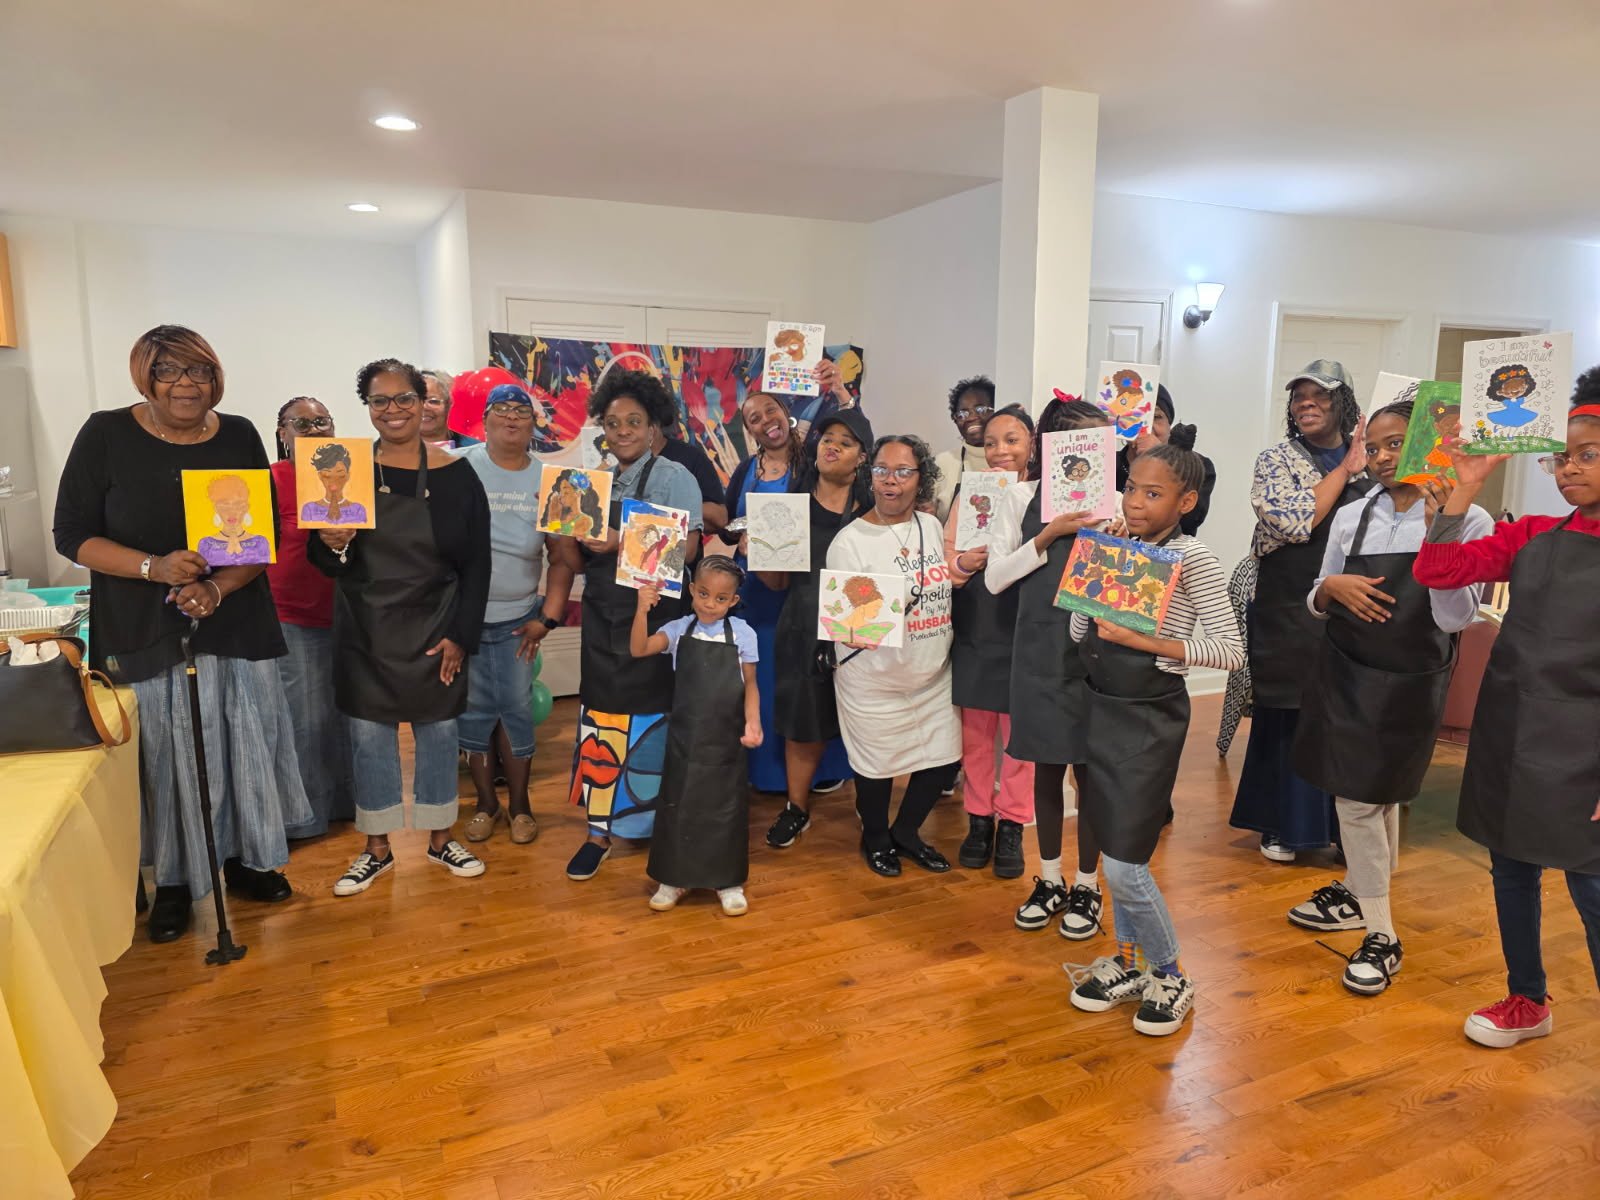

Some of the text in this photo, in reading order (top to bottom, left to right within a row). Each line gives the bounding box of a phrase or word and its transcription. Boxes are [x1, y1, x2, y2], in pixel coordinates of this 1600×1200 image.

[1501, 341, 1529, 351] I am
[1069, 434, 1088, 442] I am
[1056, 442, 1098, 455] unique
[909, 629, 939, 642] Protected
